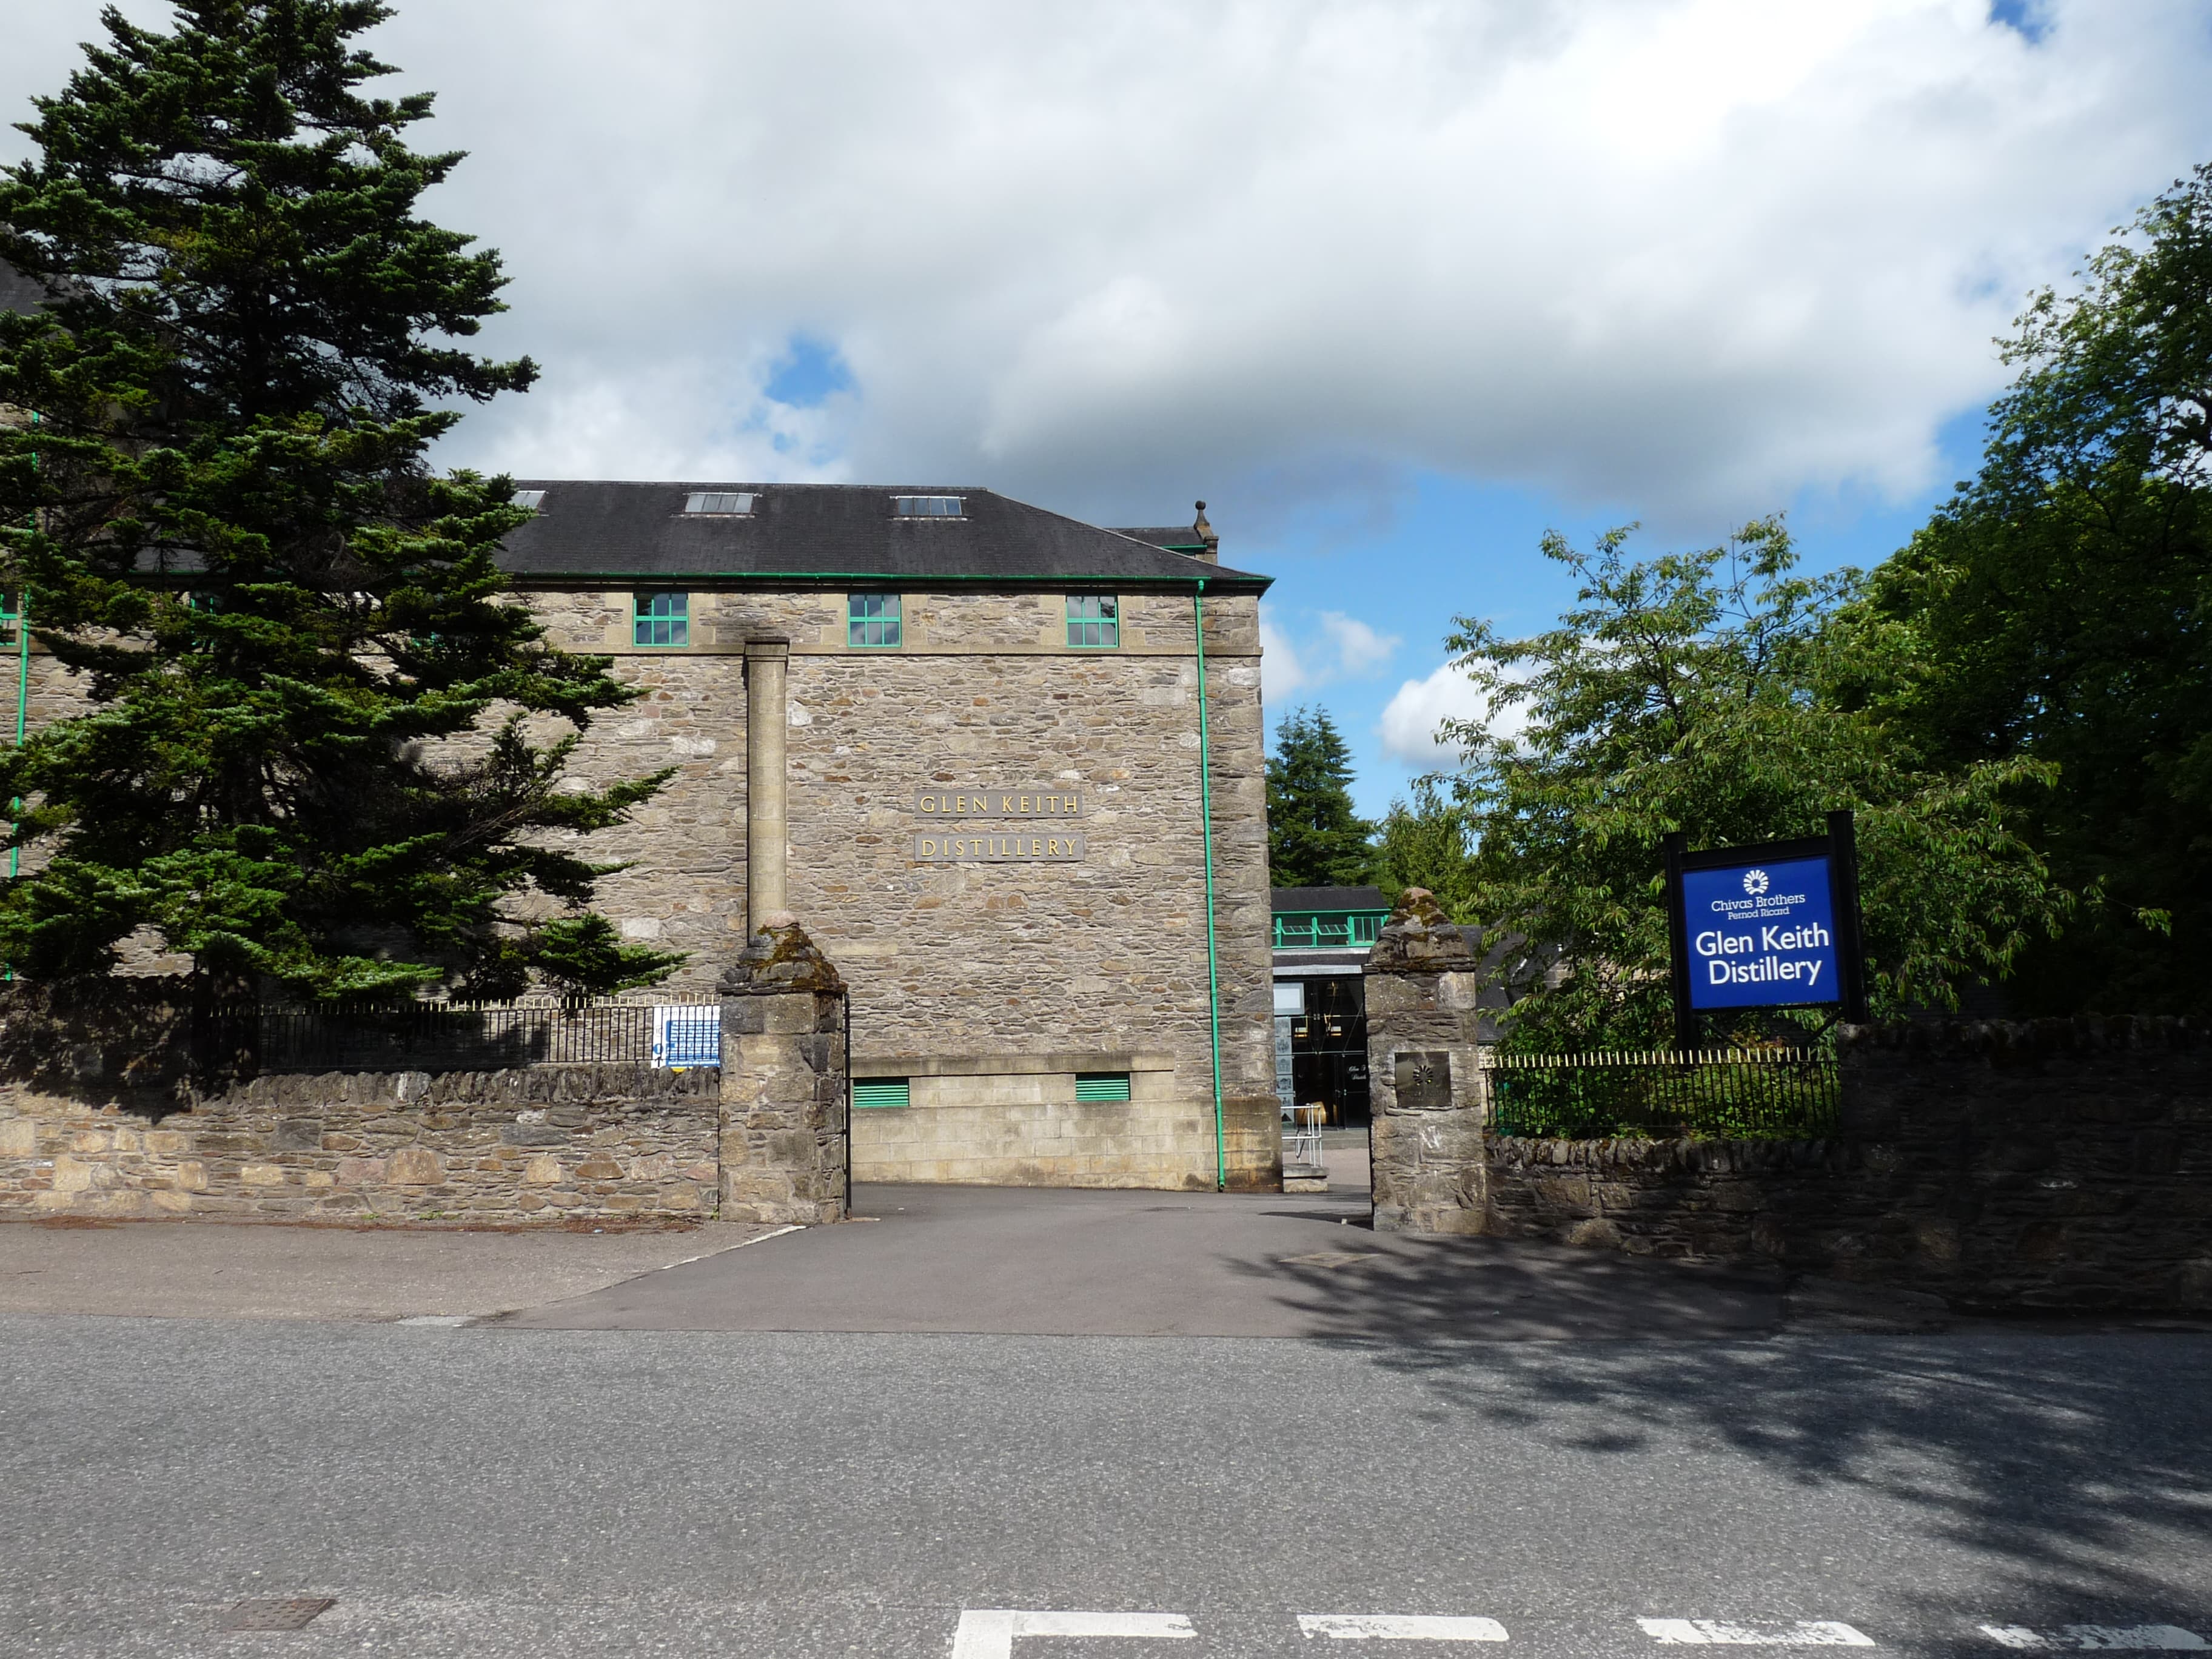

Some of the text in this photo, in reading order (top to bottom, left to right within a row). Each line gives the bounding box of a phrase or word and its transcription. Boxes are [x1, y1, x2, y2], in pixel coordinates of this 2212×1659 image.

[920, 796, 1078, 813] GLEN KEITH
[921, 839, 1077, 857] DISTILLERY
[1711, 894, 1806, 912] Chivas Brothers
[1728, 907, 1790, 920] Pernod Ricard
[1695, 922, 1829, 956] Glen Keith
[1709, 956, 1822, 986] Distillery
